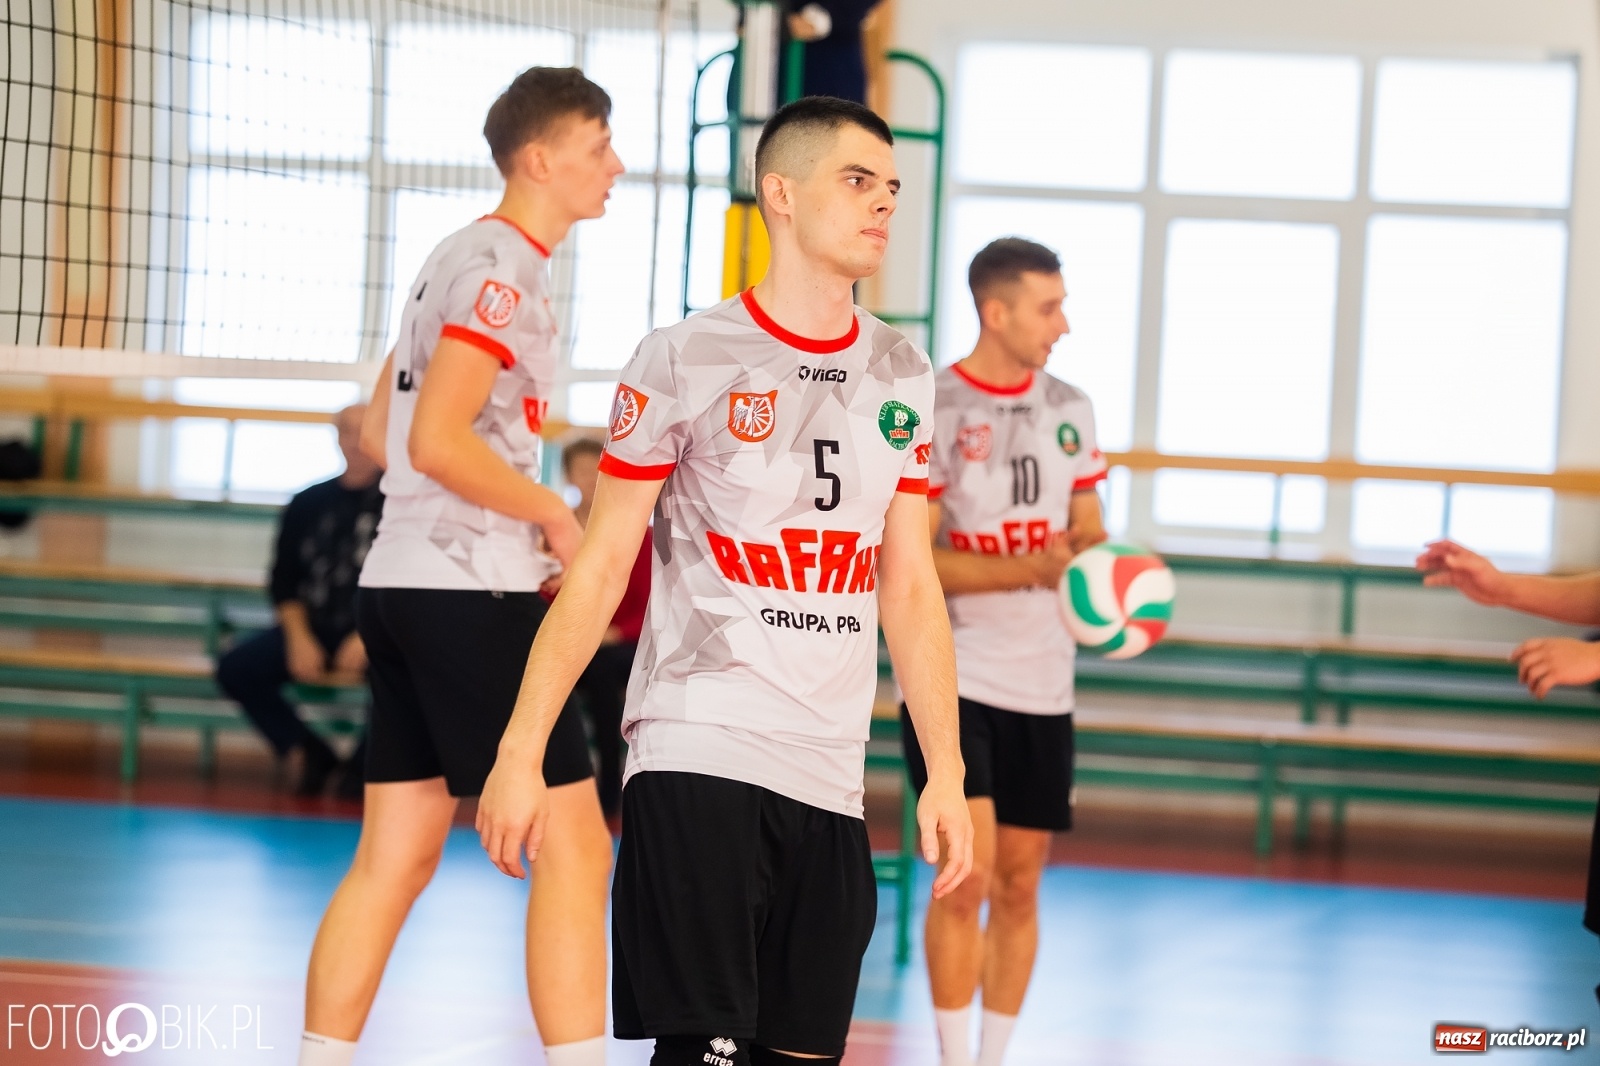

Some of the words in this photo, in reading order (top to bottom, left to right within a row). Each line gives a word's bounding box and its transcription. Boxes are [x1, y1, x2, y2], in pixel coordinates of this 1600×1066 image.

[813, 438, 841, 512] 5
[1011, 454, 1041, 507] 10
[760, 608, 831, 633] GRUPA
